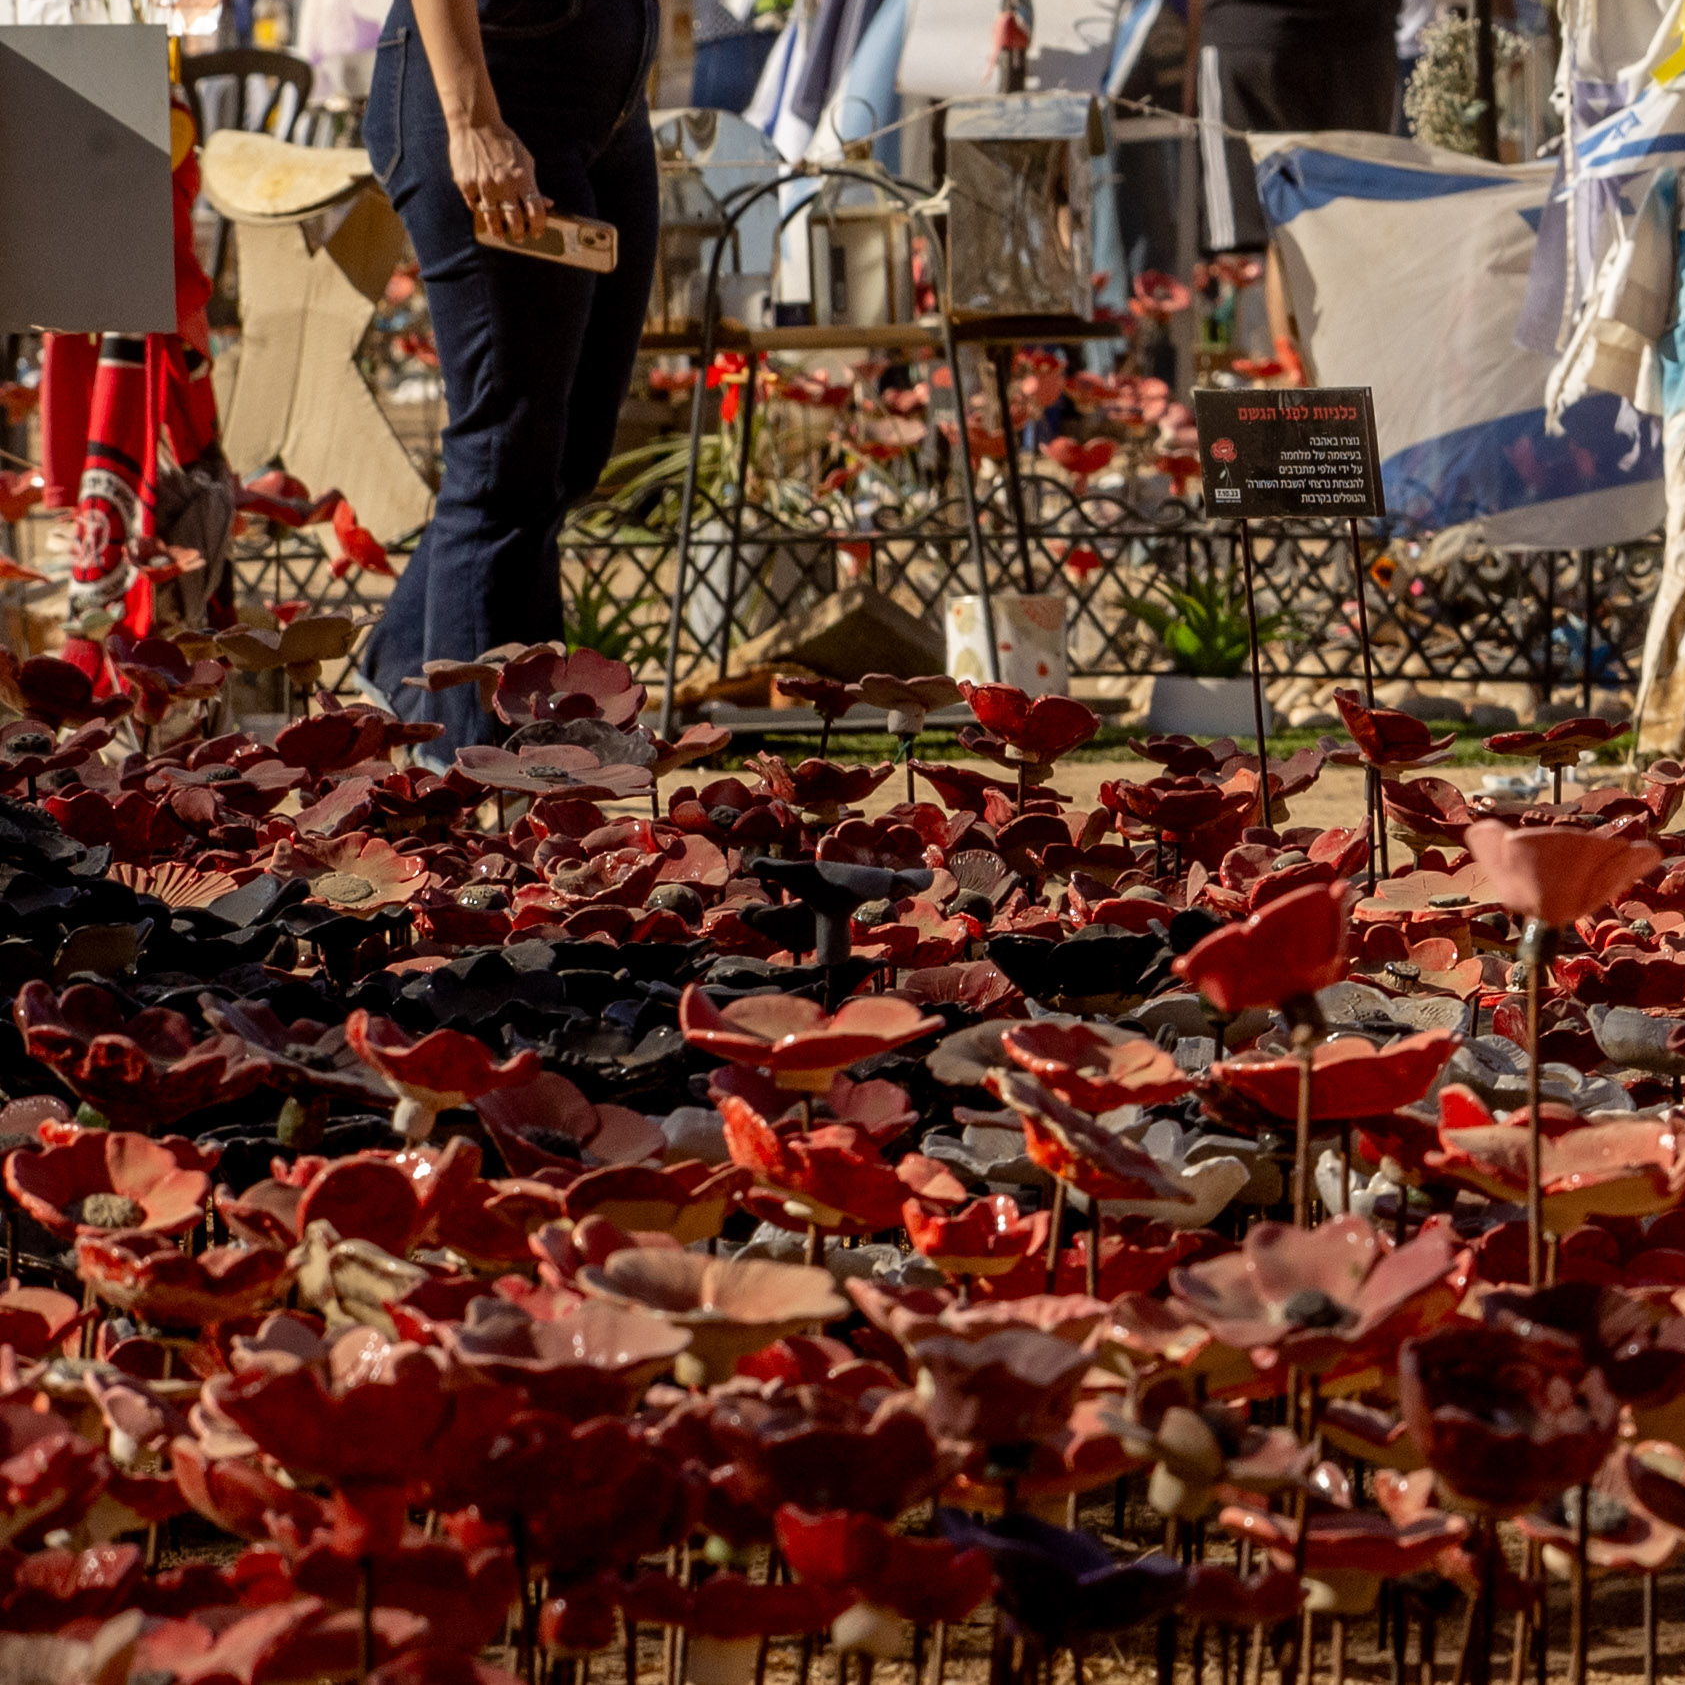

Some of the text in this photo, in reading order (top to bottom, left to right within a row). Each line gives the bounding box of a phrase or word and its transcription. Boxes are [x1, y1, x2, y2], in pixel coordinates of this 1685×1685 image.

[1237, 405, 1358, 421] כלניות לפני הגשם
[1309, 436, 1360, 446] נוצרו באהבה
[1280, 449, 1362, 461] בעיצומה של מלחמה
[1278, 464, 1363, 475] על ידי אלפי מתנדבים
[1308, 479, 1332, 489] נרצחי
[1332, 478, 1365, 489] להנצחת
[1301, 492, 1367, 504] והנופלים בקרבות
